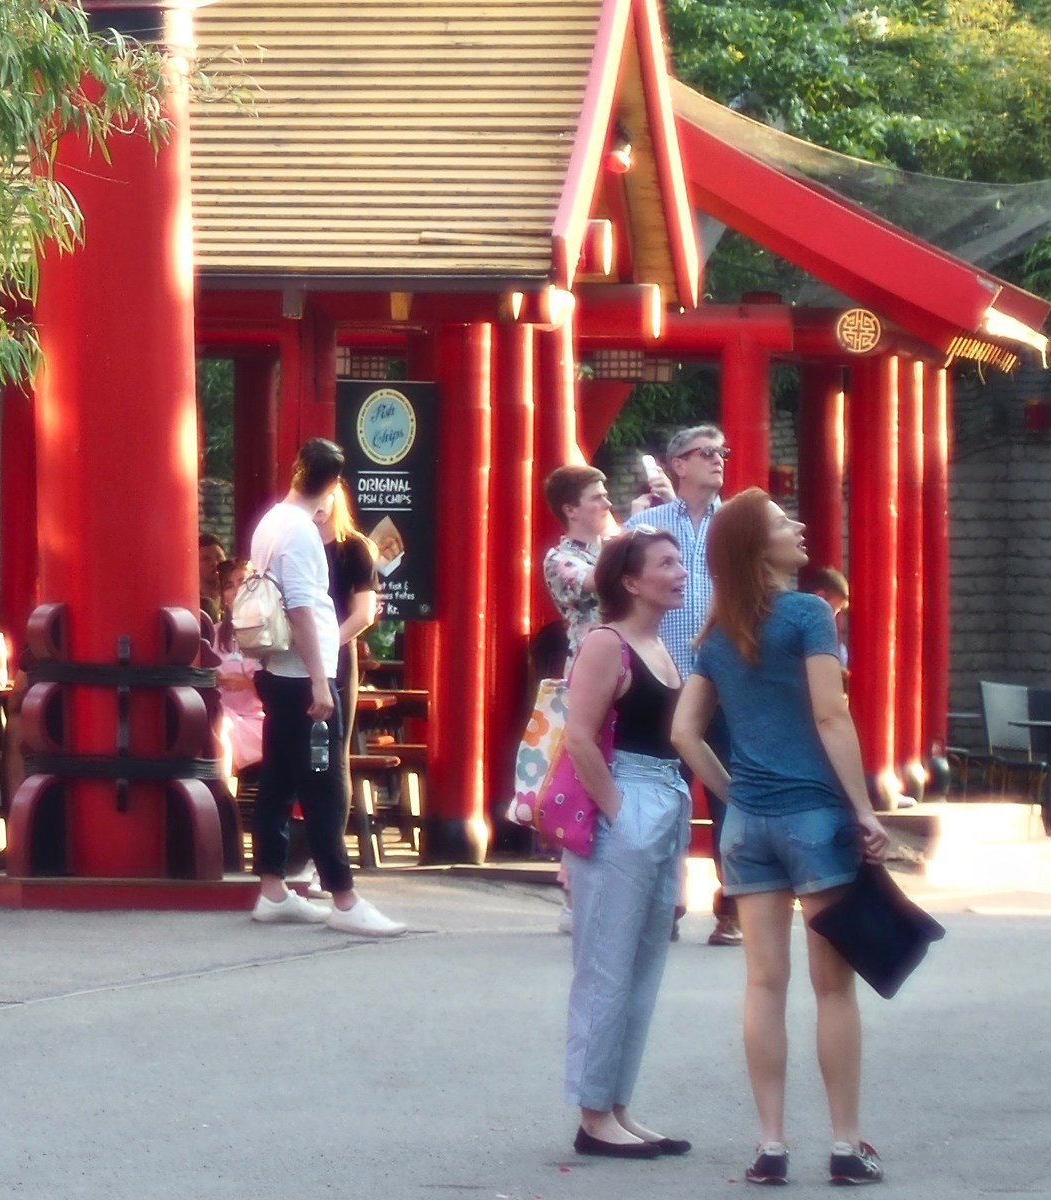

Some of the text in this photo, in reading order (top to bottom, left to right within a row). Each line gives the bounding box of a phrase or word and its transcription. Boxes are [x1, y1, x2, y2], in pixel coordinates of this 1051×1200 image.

[371, 404, 395, 422] Fish
[372, 429, 404, 448] Chips
[358, 478, 412, 492] ORIGINAL
[358, 493, 412, 505] FISH & CHIPS
